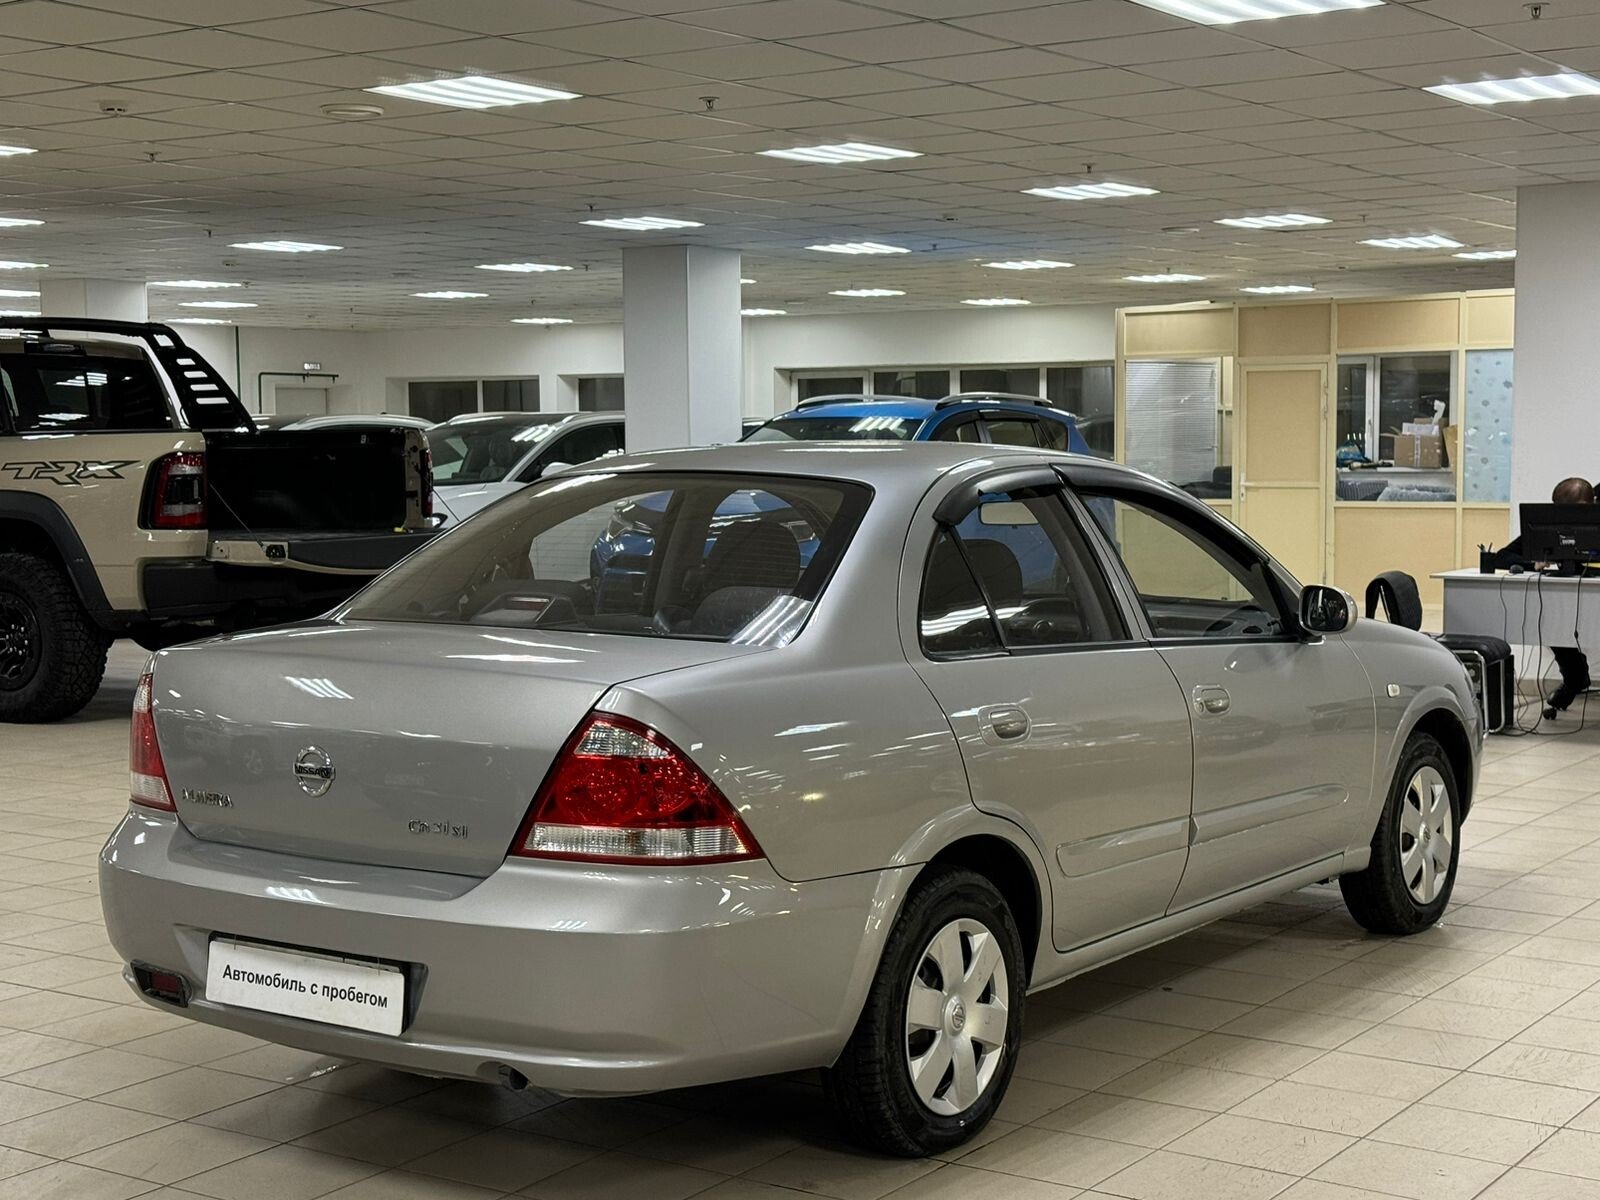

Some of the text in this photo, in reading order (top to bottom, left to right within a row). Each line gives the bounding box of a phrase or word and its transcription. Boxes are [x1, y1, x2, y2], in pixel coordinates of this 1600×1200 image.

[1, 459, 141, 486] TRX
[295, 765, 331, 778] NISSAN
[222, 964, 388, 1008] Автомобиль с пробегом
